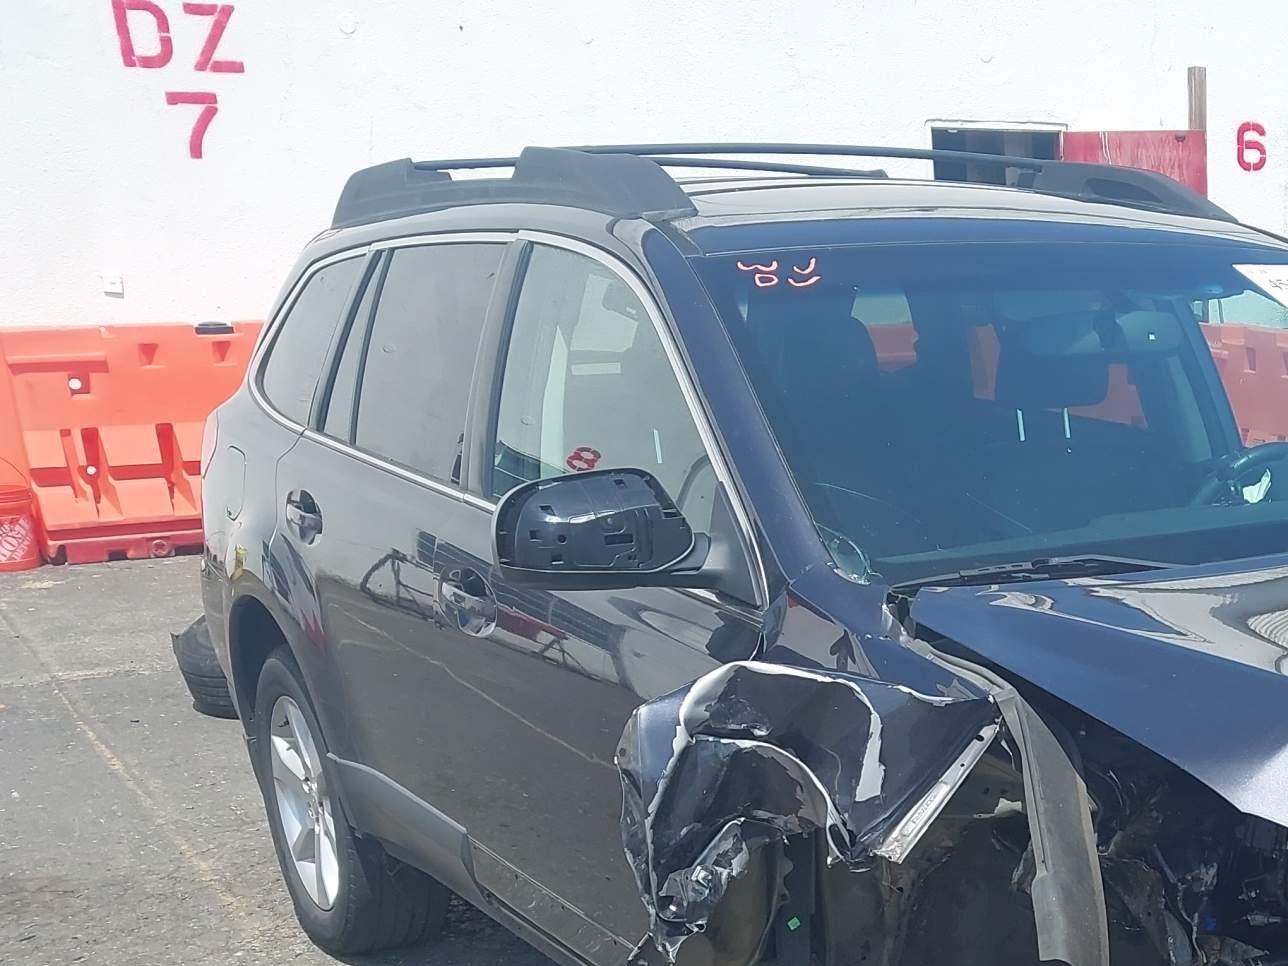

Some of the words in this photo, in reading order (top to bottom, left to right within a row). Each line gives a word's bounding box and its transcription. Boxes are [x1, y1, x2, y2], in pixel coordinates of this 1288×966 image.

[111, 0, 245, 74] DZ
[165, 91, 218, 159] 7
[1236, 121, 1267, 172] 6
[566, 446, 601, 472] 8
